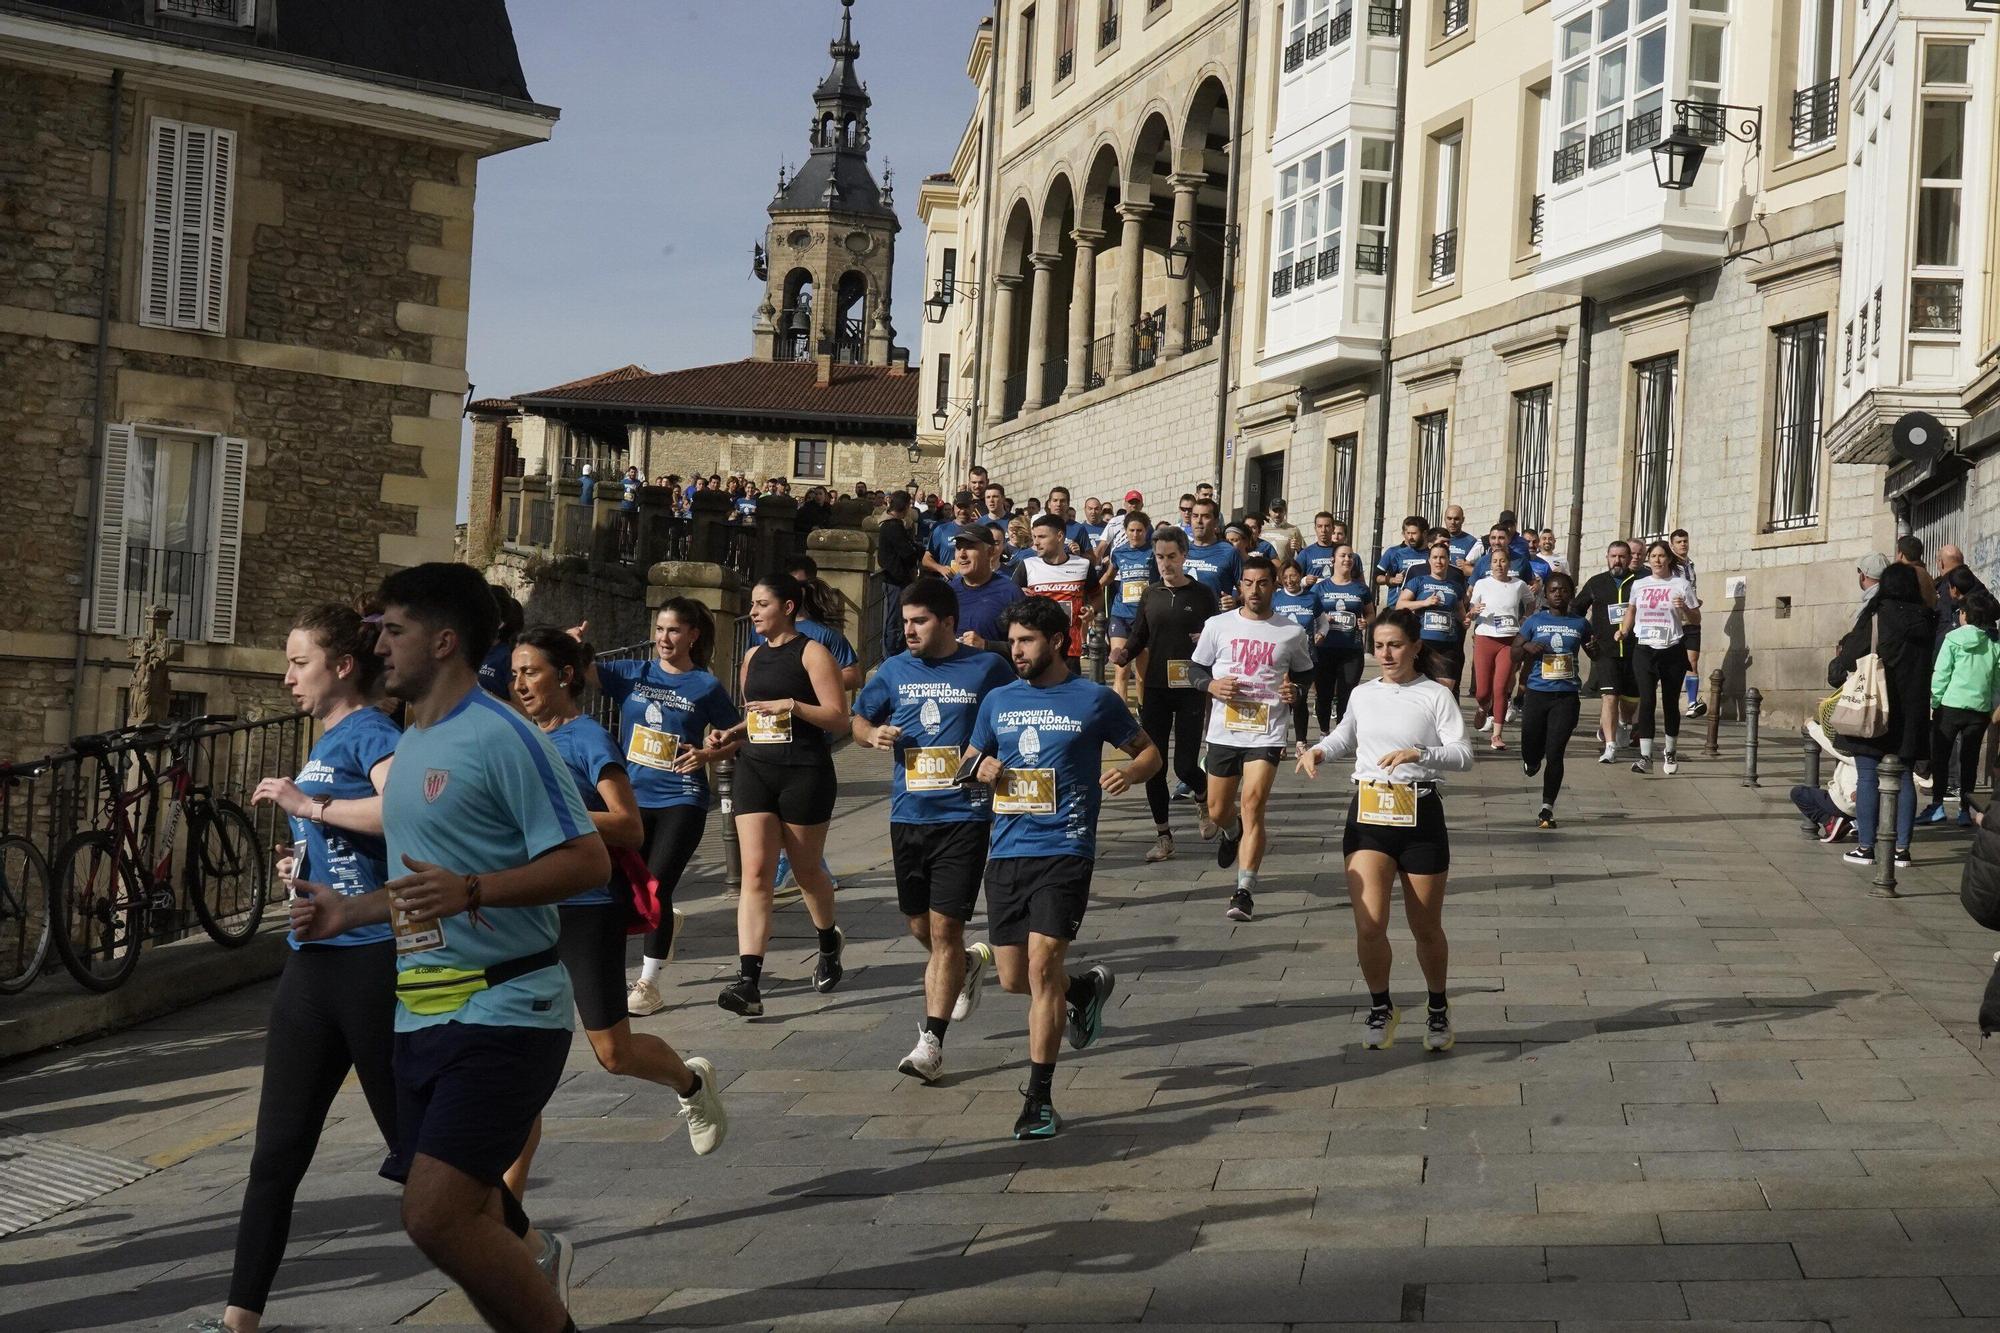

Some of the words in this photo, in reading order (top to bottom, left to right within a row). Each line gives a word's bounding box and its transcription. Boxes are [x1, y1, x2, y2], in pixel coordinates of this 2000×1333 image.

[1034, 583, 1081, 592] ORKATZAK
[1616, 608, 1628, 617] 97
[1334, 615, 1350, 624] 1007
[1430, 614, 1448, 624] 1008
[1230, 638, 1276, 667] 170K
[907, 682, 951, 690] CONQUISTA
[639, 690, 687, 704] ALMENDRA
[908, 688, 967, 698] ALMENDRA
[938, 696, 977, 704] KONKISTA
[1007, 709, 1054, 718] CONQUISTA
[1007, 715, 1070, 726] ALMENDRA
[1039, 724, 1082, 733] KONKISTA
[643, 738, 662, 755] 116
[917, 757, 946, 774] 660
[1007, 780, 1039, 798] 604
[1377, 792, 1395, 809] 75
